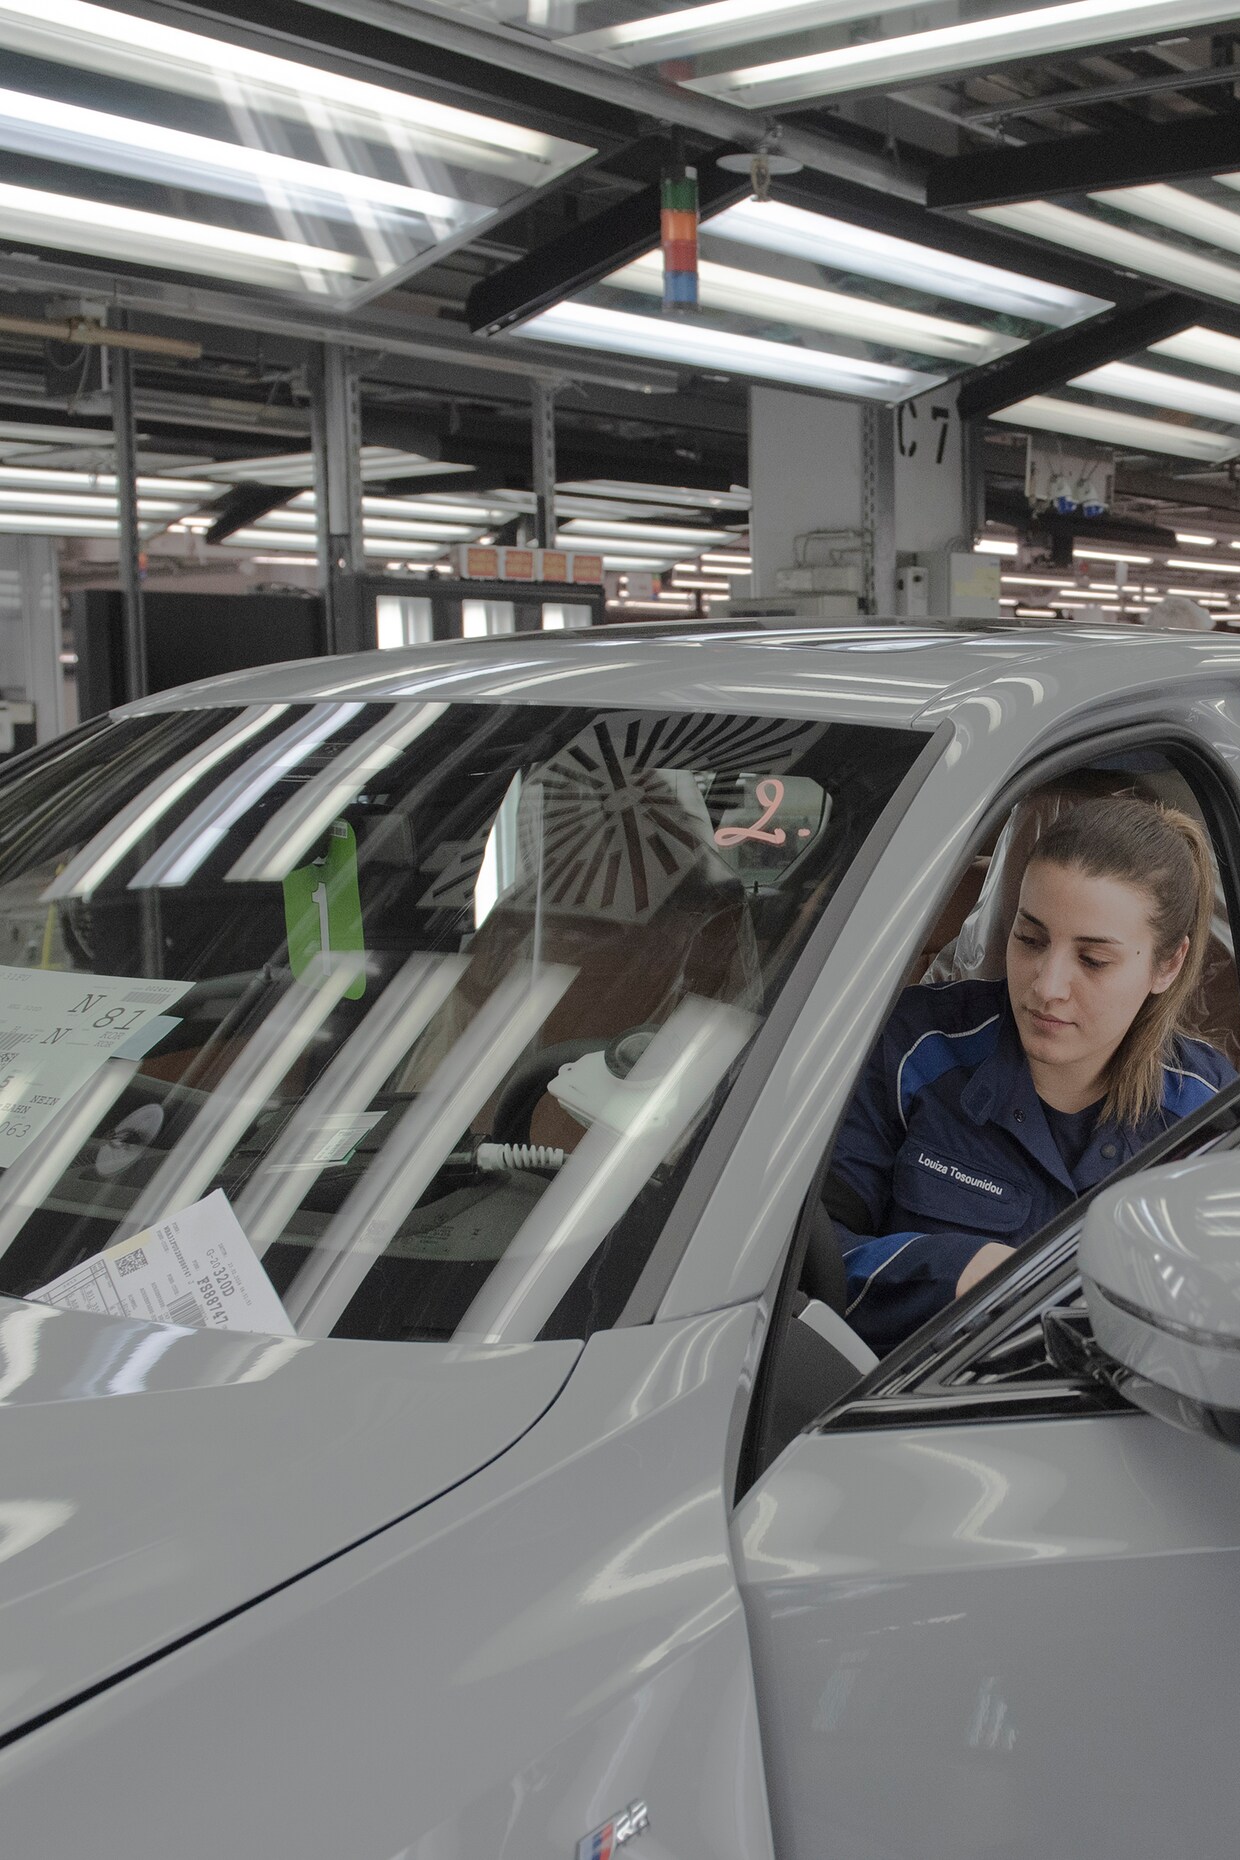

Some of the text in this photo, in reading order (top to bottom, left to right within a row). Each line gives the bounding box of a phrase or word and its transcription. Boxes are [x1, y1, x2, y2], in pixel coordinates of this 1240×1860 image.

[68, 993, 107, 1014] N
[93, 1007, 146, 1031] 81
[40, 1027, 72, 1045] N
[30, 1094, 60, 1106] NEIN
[918, 1153, 1003, 1195] Louiza Tosounidou
[213, 1266, 235, 1297] 320D
[197, 1276, 229, 1325] FS88747
